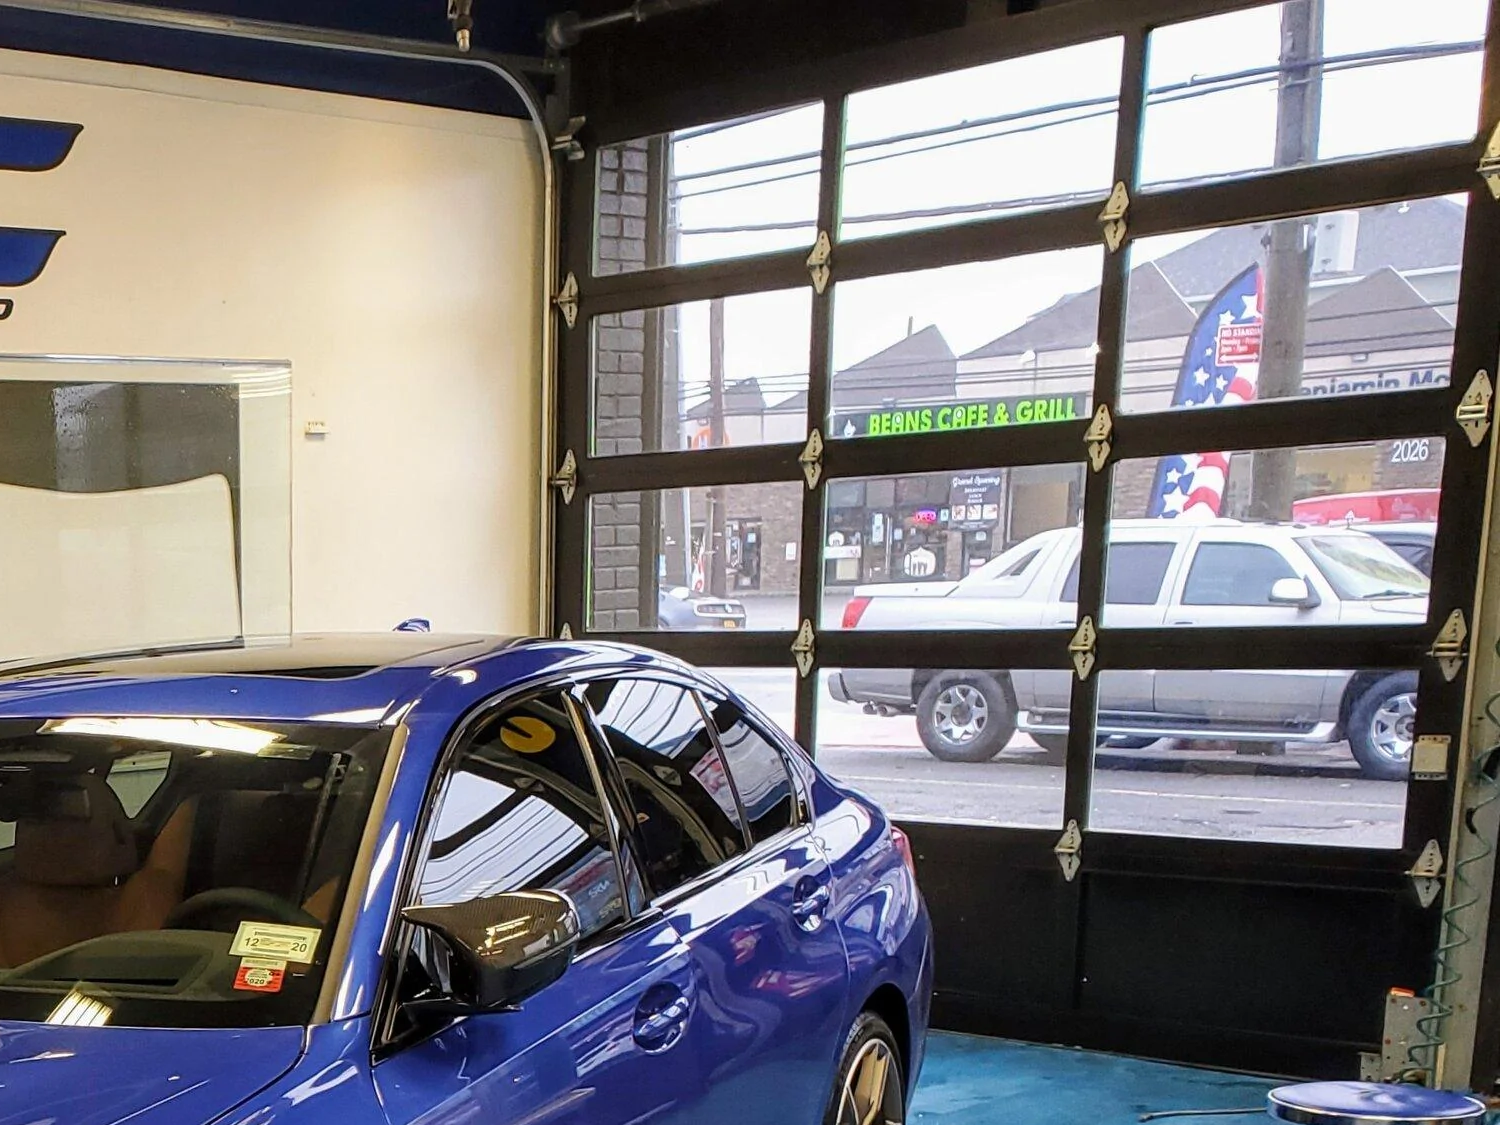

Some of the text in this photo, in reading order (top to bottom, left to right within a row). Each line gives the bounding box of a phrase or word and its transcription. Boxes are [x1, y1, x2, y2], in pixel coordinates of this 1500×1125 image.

[1300, 373, 1400, 396] enjamin
[868, 398, 1077, 437] BEANS CAFE & GRILL
[1391, 439, 1430, 462] 2026
[244, 937, 259, 947] 12
[291, 942, 307, 952] 20
